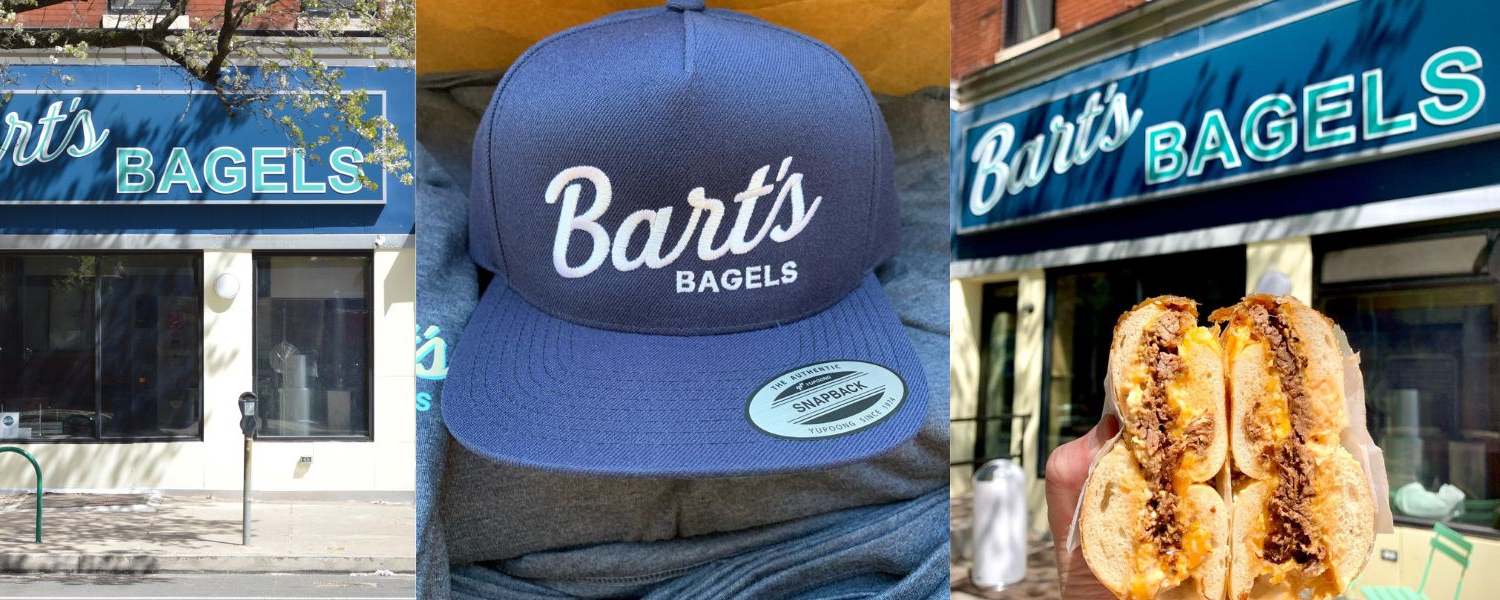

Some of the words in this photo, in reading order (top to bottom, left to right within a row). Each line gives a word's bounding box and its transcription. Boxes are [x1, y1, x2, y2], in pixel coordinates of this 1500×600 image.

[969, 82, 1143, 216] Bart's
[1145, 46, 1486, 185] BAGELS
[116, 146, 365, 194] BAGELS
[545, 156, 822, 278] Bart's
[675, 261, 798, 293] BAGELS
[770, 379, 787, 391] THE
[790, 364, 841, 381] AUTHENTIC
[805, 375, 832, 387] YUPOONG
[792, 380, 868, 413] SNAPBACK
[808, 420, 856, 434] YUPOONG
[859, 409, 882, 423] SINCE
[882, 396, 897, 410] 1974
